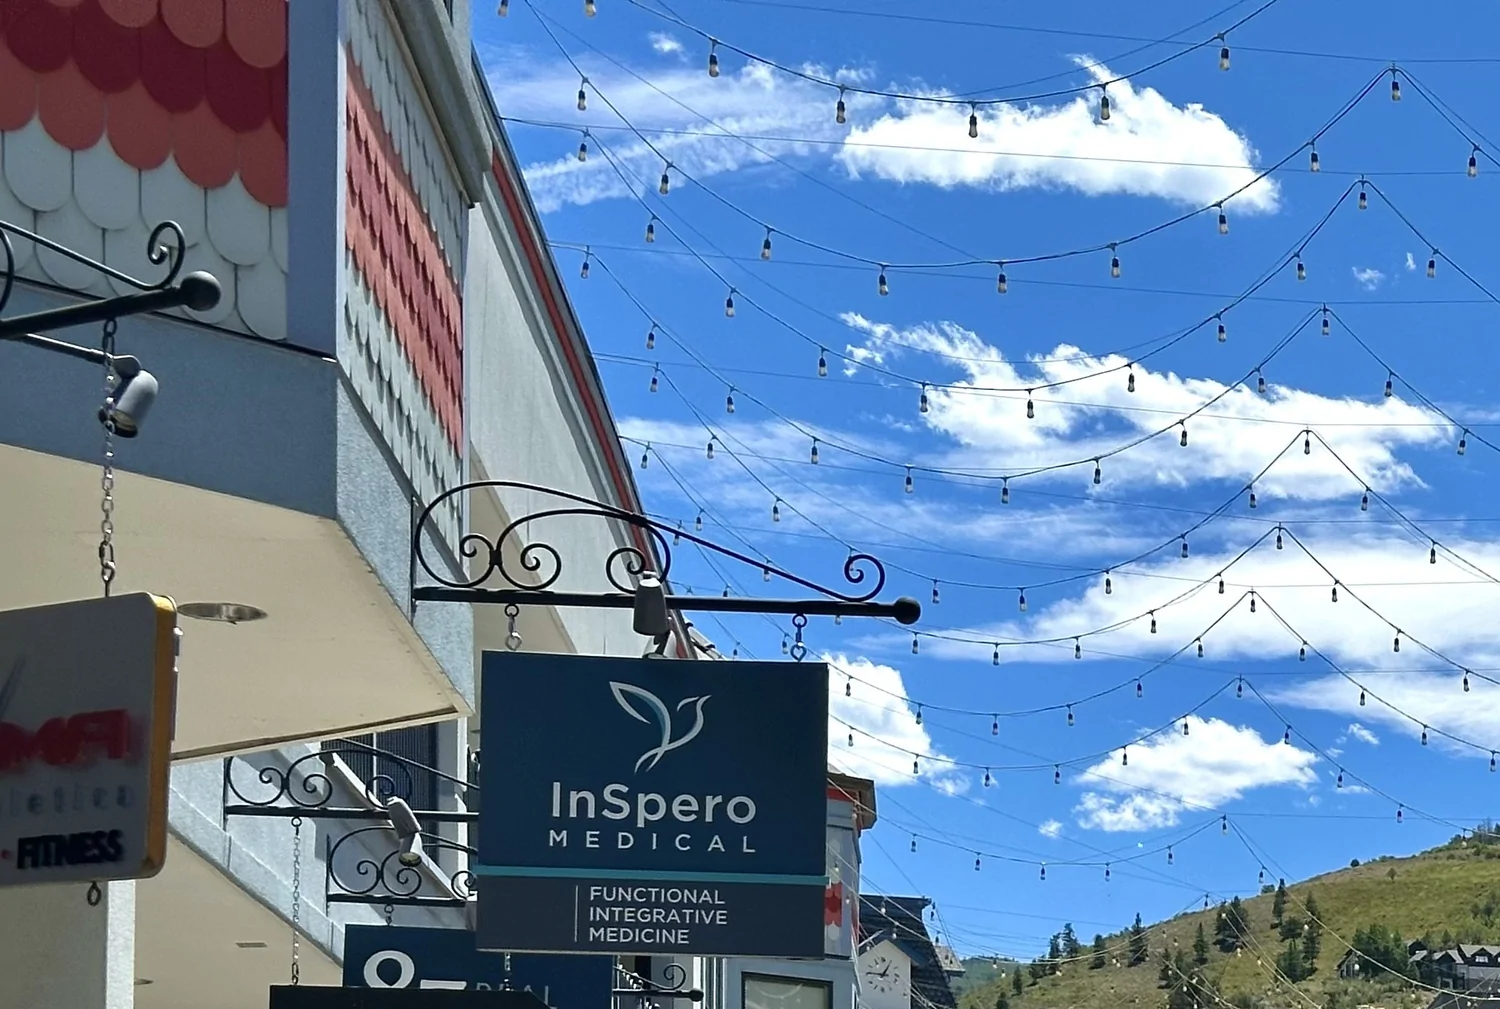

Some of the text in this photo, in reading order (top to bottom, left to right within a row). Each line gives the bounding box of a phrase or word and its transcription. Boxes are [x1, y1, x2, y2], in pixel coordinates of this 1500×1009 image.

[552, 781, 757, 828] InSpero
[17, 829, 124, 870] FITNESS
[549, 829, 757, 853] MEDICAL
[589, 886, 726, 905] FUNCTIONAL
[589, 907, 728, 925] INTEGRATIVE
[589, 928, 690, 945] MEDICINE
